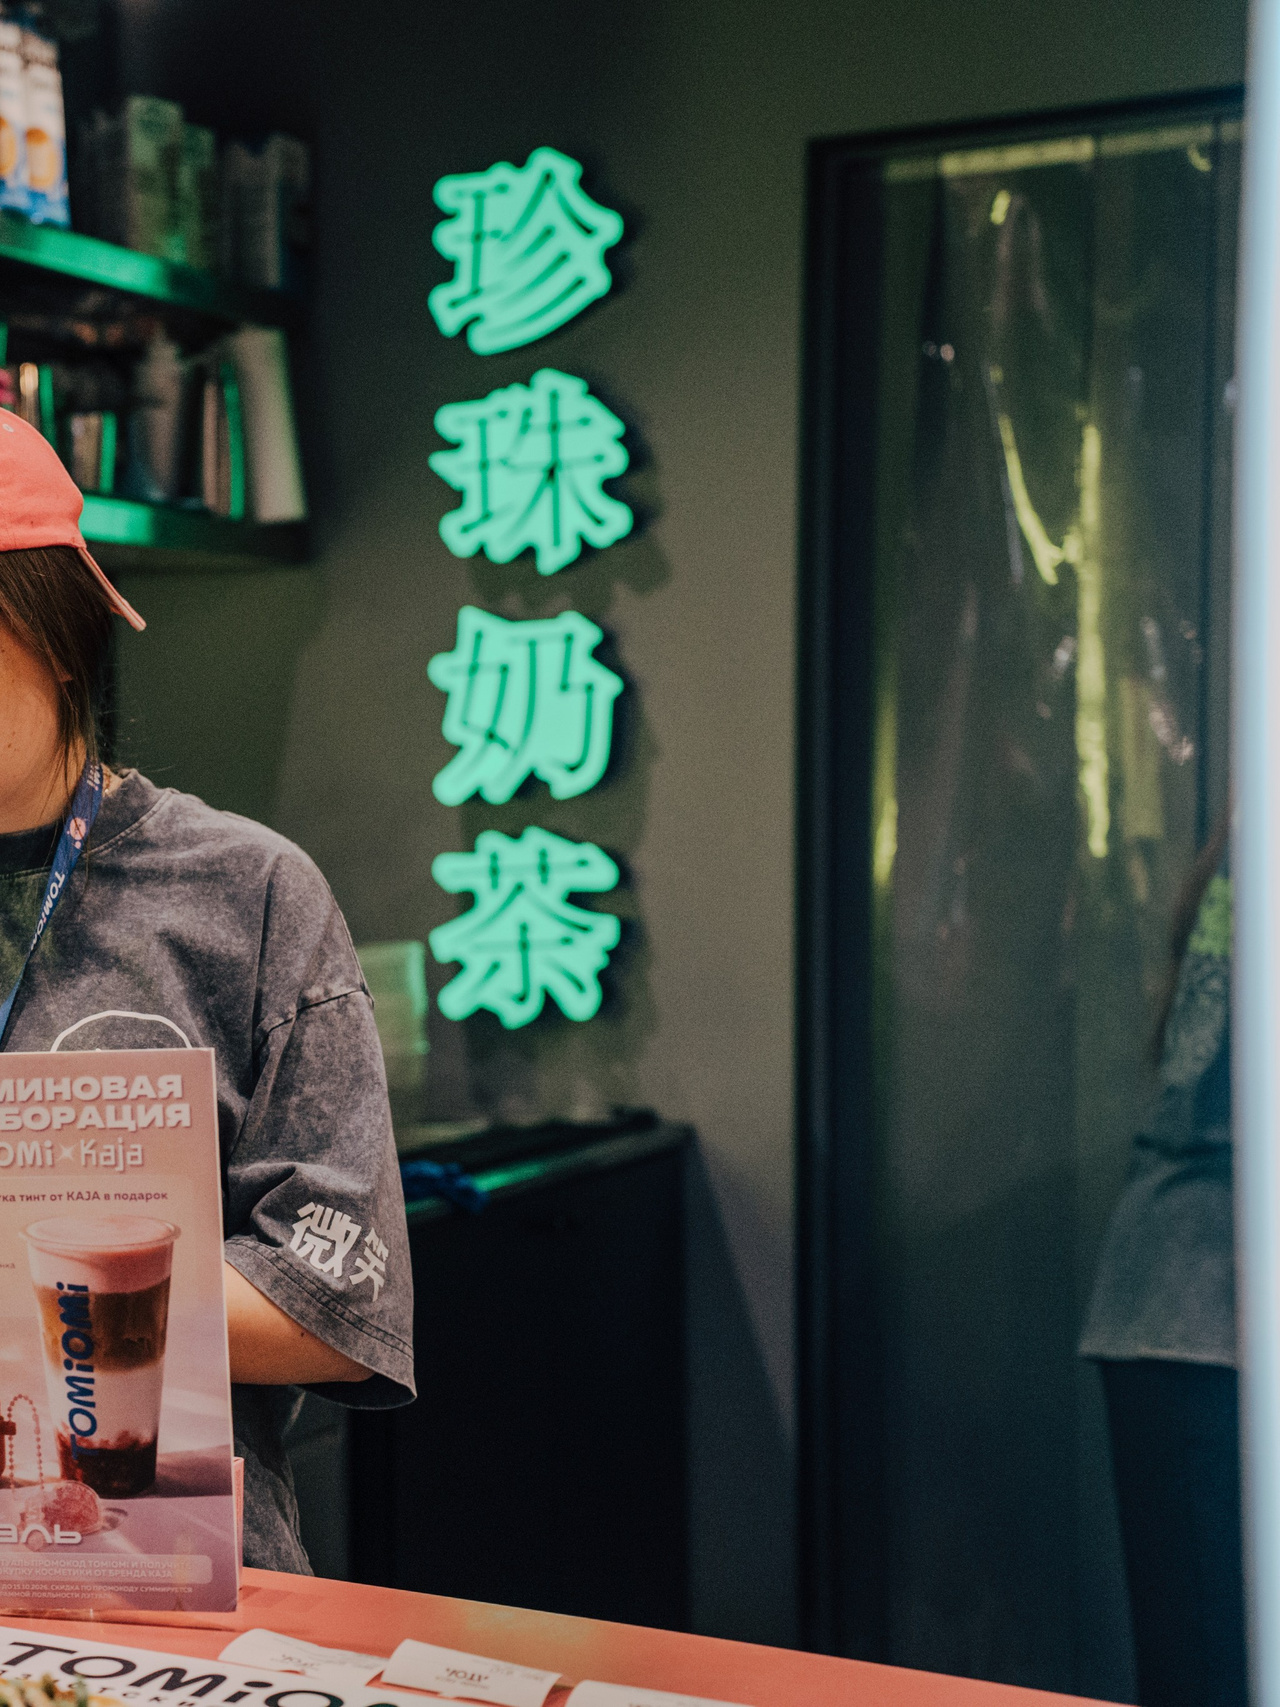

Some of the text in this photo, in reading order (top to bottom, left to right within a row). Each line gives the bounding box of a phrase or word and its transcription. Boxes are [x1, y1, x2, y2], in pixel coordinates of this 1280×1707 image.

[428, 146, 634, 1029] 珍珠奶茶
[79, 1137, 144, 1172] Kaja
[19, 1193, 46, 1202] тинт
[49, 1193, 63, 1202] от
[66, 1191, 101, 1201] KAJA
[103, 1192, 111, 1200] в
[114, 1191, 169, 1203] подарок
[31, 1559, 86, 1568] ПРОМОКОД
[35, 1568, 93, 1577] КОСМЕТИКИ
[94, 1568, 106, 1577] ОТ
[108, 1569, 147, 1578] БРЕНДА
